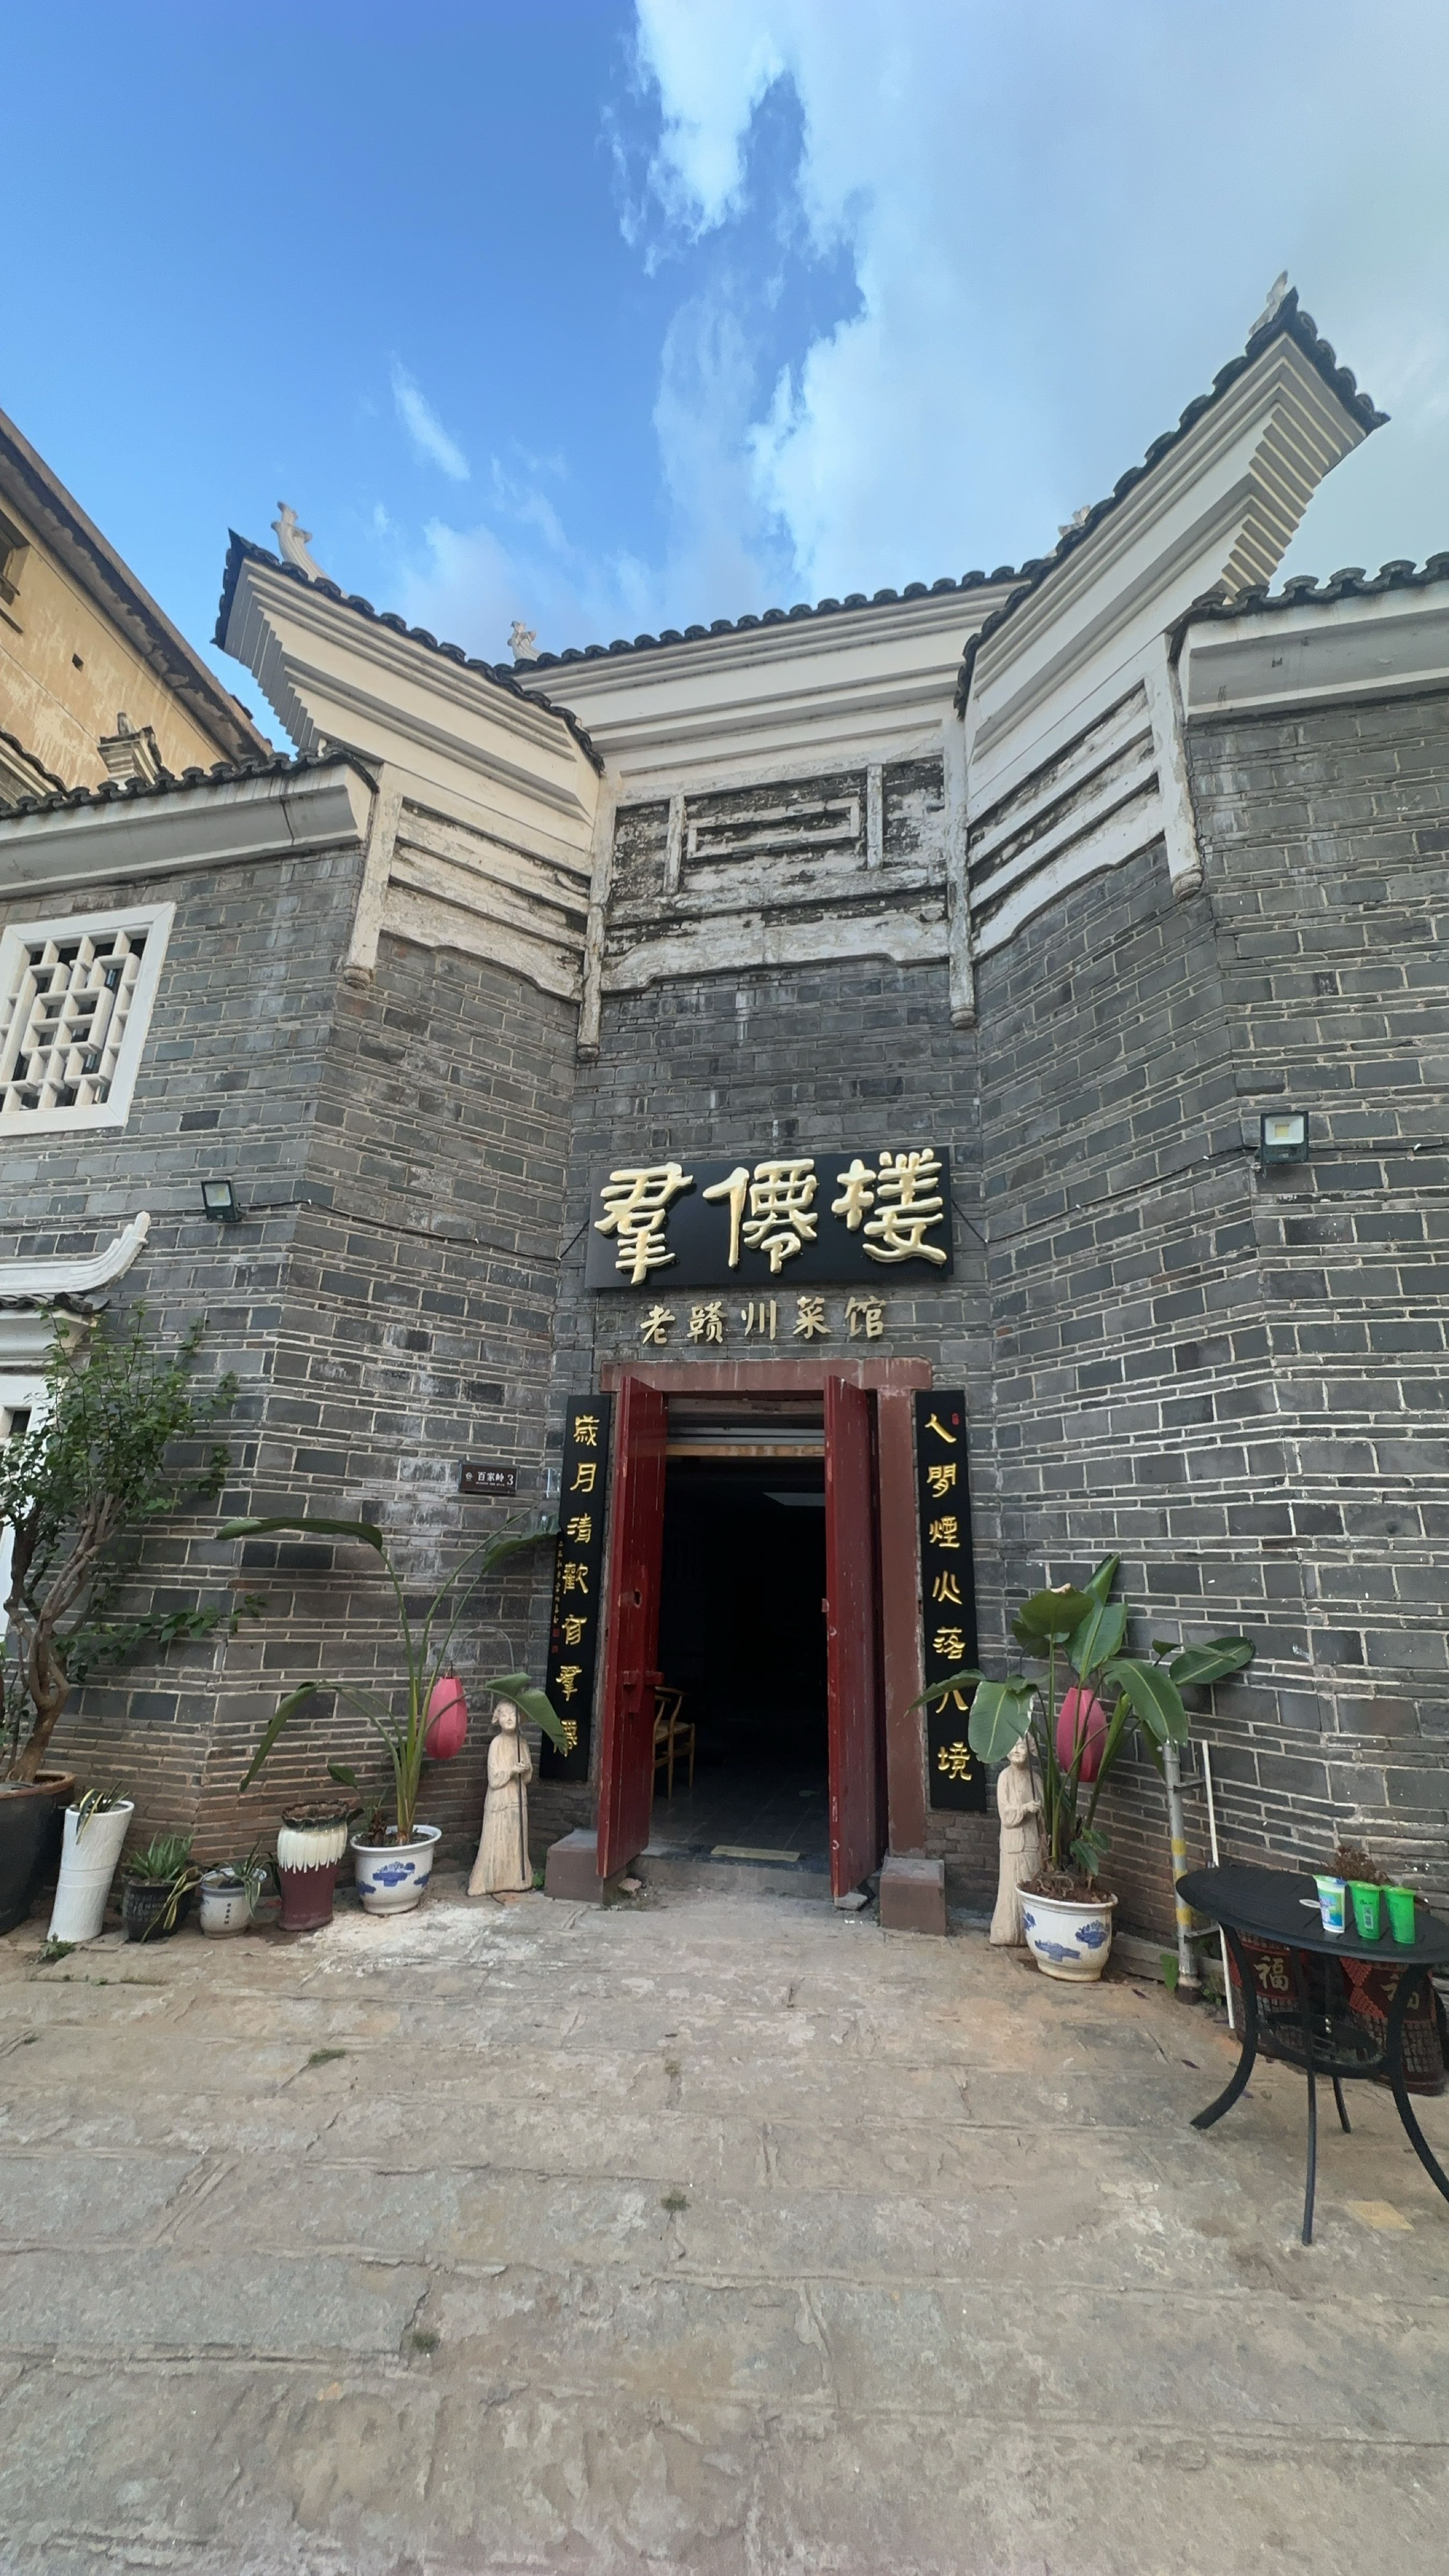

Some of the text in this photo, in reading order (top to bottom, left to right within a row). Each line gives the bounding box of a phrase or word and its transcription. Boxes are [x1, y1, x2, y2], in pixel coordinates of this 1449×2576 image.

[640, 1296, 886, 1344] 老赣州菜馆
[507, 1474, 514, 1485] 3
[1253, 1956, 1289, 1990] 福
